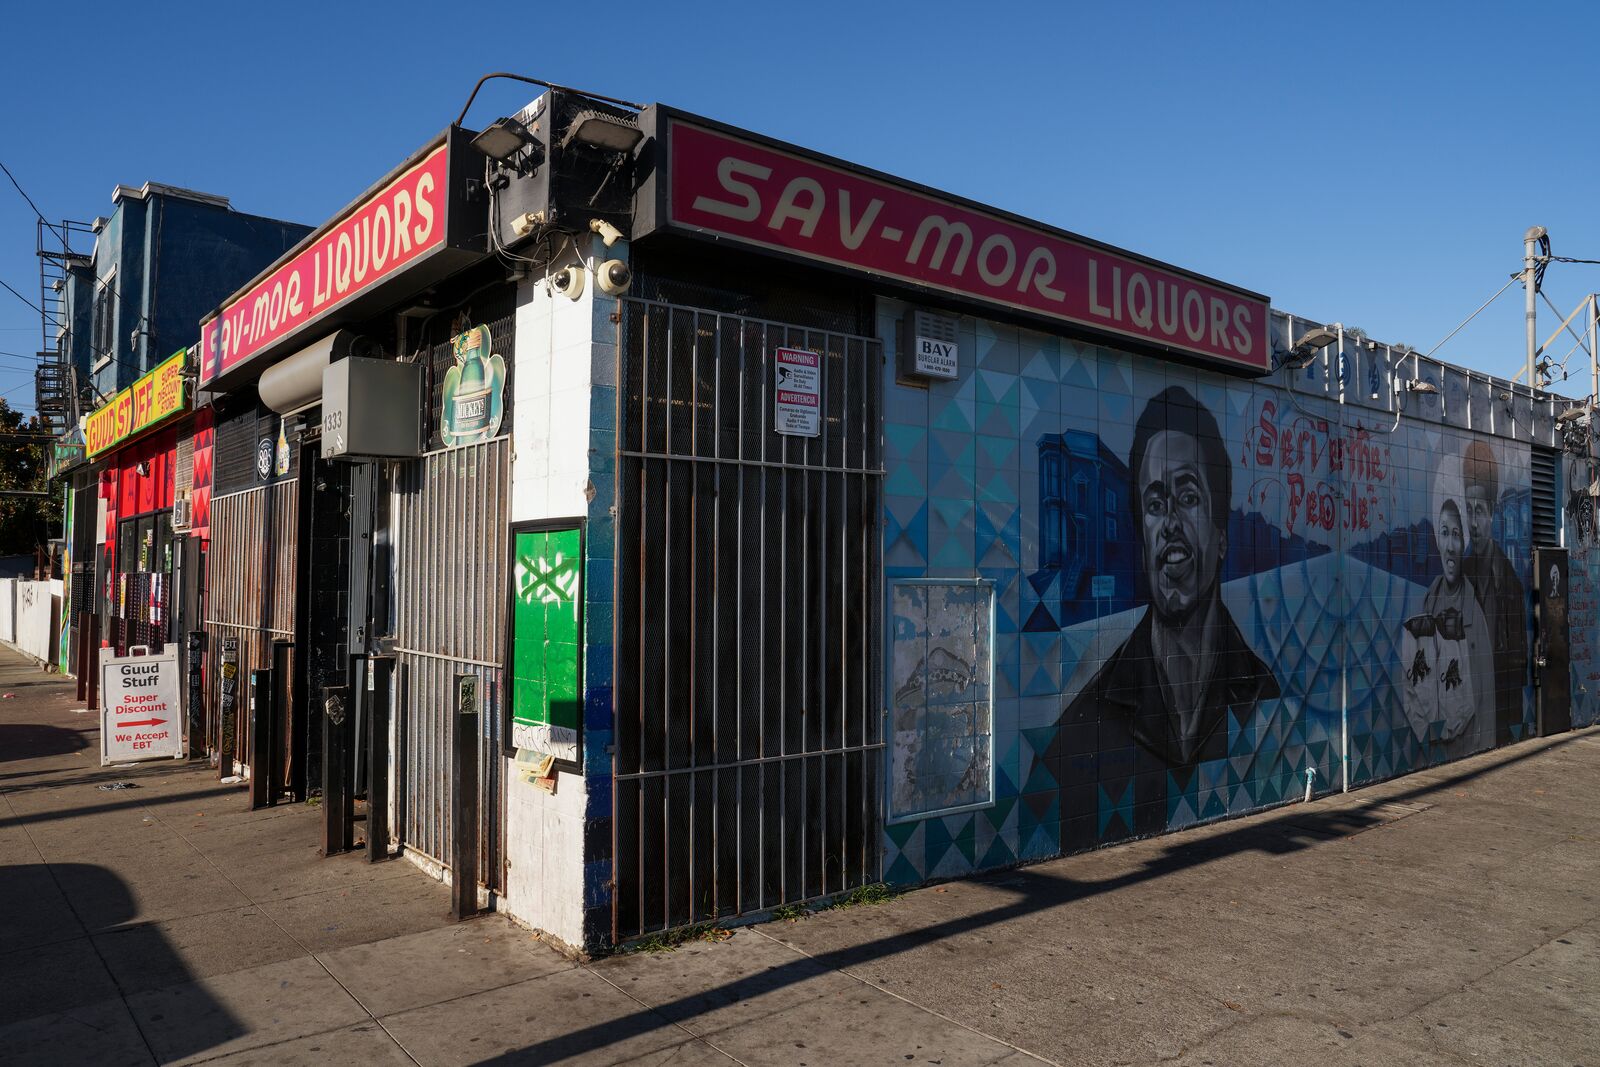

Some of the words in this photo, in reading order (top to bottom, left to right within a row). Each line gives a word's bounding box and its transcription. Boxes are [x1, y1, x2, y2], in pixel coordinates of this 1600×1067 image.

[692, 156, 1066, 304] SAV-MOR
[1088, 258, 1254, 357] LIQUORS
[206, 269, 304, 373] SAV-MOR
[313, 170, 436, 308] LIQUORS
[923, 341, 953, 357] BAY
[782, 352, 815, 365] WARNING
[918, 353, 939, 365] BURGLAR
[940, 358, 956, 367] ALARM
[161, 364, 178, 386] SUPER
[157, 380, 181, 405] DISCOUNT
[780, 392, 816, 405] ADVERTENCIA
[160, 396, 176, 415] STORE
[89, 407, 115, 453] GUUD
[117, 382, 153, 438] STUFF
[324, 410, 342, 433] 1333
[120, 662, 160, 676] Guud
[122, 675, 159, 688] Stuff
[123, 694, 159, 705] Super
[115, 702, 168, 715] Discount
[115, 734, 132, 743] We
[134, 731, 169, 742] Accept
[132, 741, 153, 750] EBT
